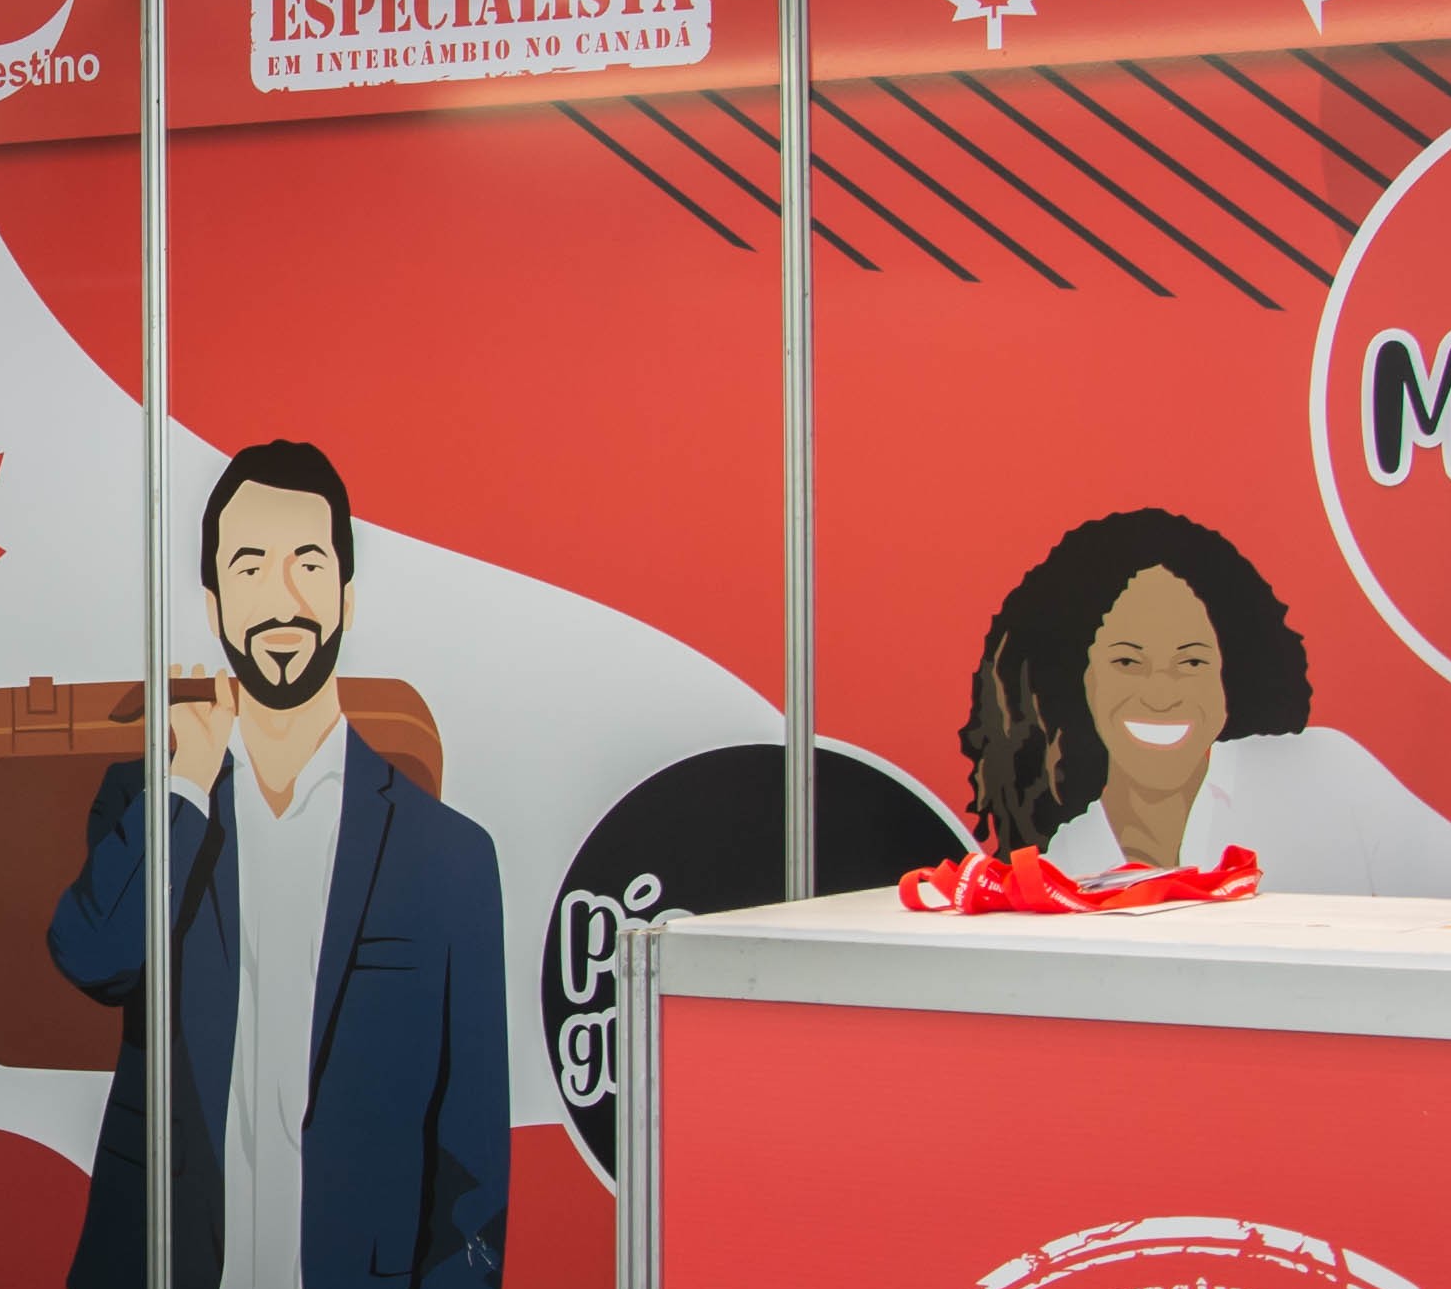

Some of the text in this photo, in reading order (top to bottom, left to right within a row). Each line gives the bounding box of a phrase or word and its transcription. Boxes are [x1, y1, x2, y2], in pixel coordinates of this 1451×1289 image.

[267, 20, 692, 76] EM INTERCÂMBIO NO CANADÁ
